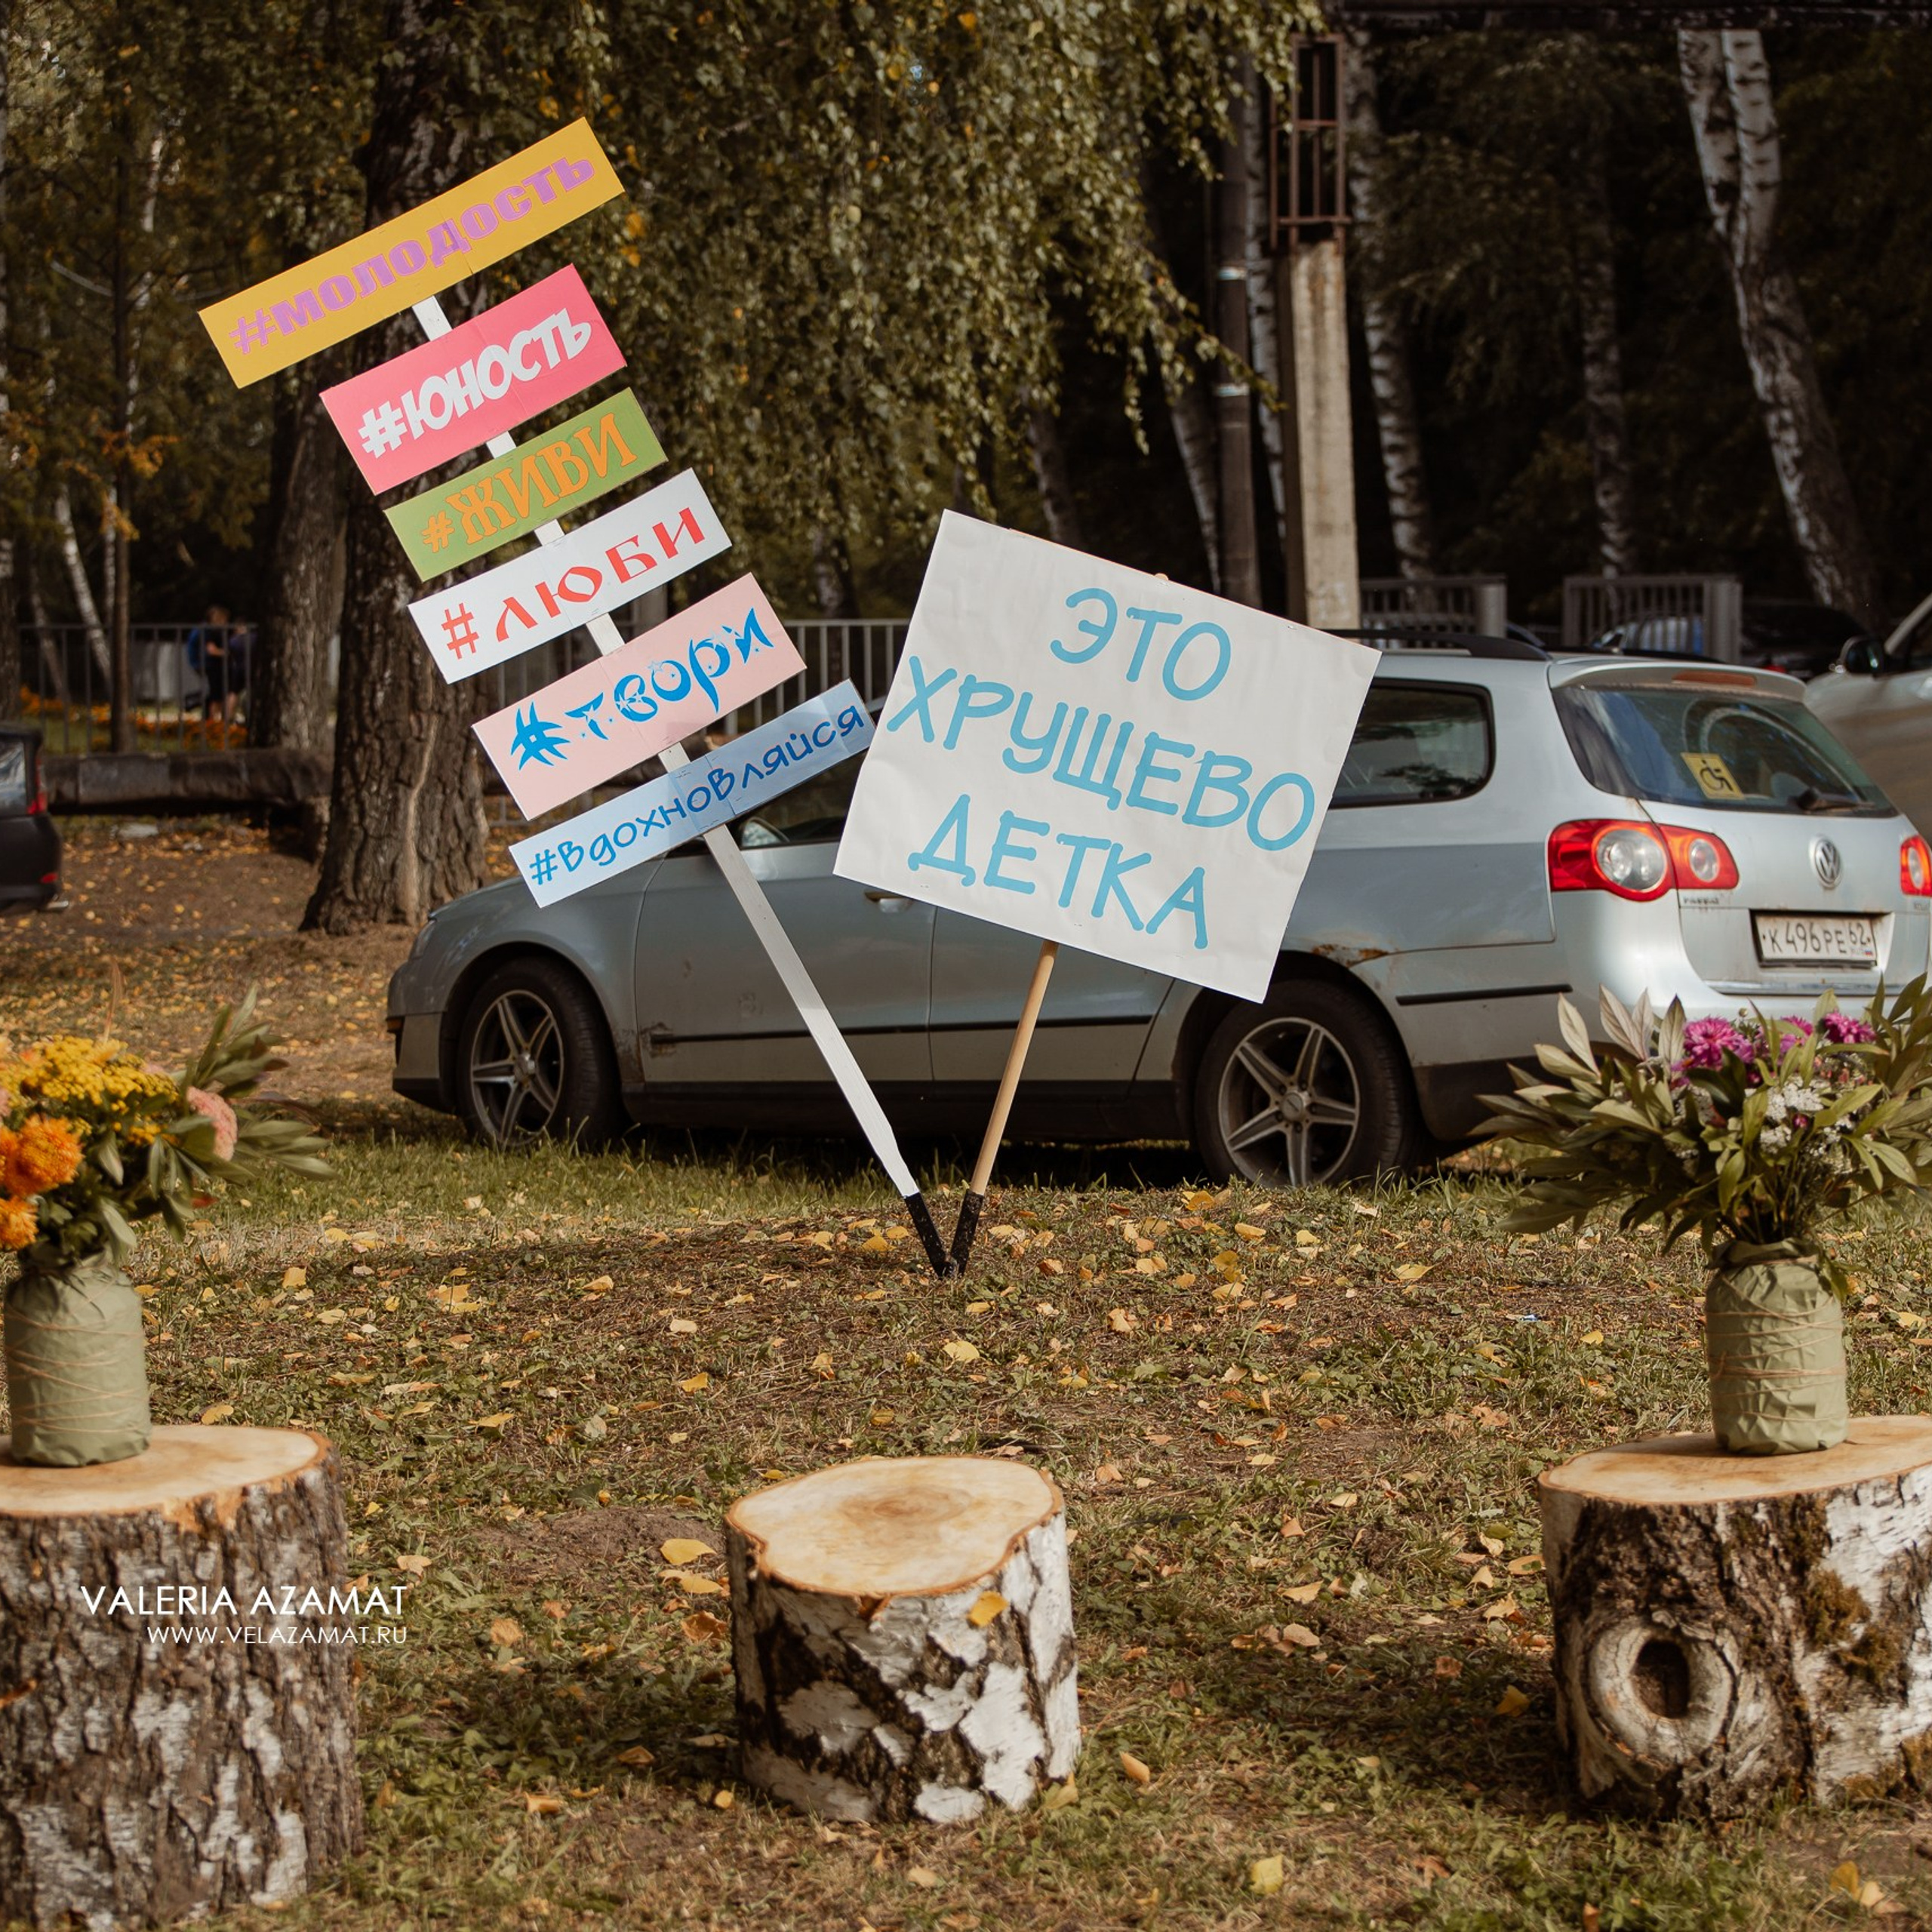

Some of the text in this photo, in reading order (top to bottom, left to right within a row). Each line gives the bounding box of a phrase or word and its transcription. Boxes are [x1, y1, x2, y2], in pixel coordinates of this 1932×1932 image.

[229, 157, 595, 355] #МОЛОДОСТЬ
[358, 308, 592, 458] #ЮНОСТЬ
[420, 412, 638, 553] #ЖИВИ
[1050, 587, 1232, 701] ЭТО
[886, 655, 1315, 851] ХРУЩЕВО
[907, 794, 1208, 949] ДЕТКА
